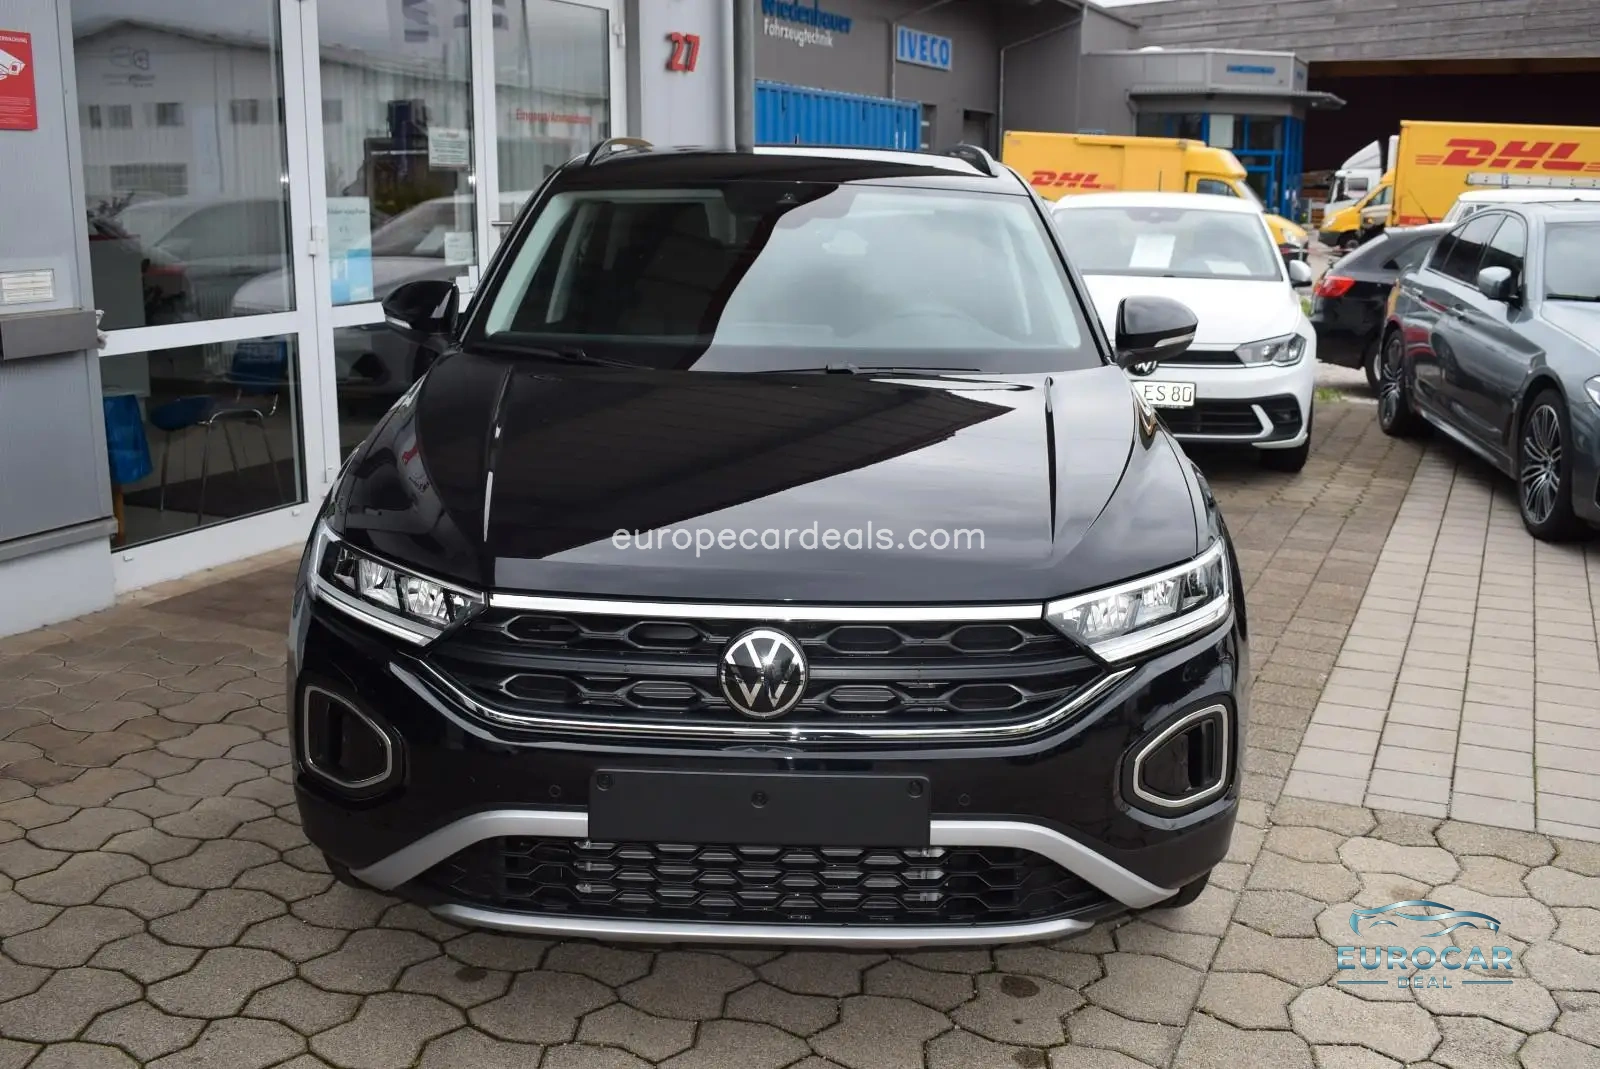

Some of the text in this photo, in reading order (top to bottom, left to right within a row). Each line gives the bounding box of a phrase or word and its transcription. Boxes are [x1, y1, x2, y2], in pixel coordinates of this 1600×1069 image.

[764, 17, 833, 47] Fahrzeugtechnik
[900, 29, 950, 66] IVECO
[667, 32, 700, 72] 27
[1442, 138, 1587, 171] DHL
[1031, 170, 1101, 189] DHL
[1171, 386, 1192, 402] 80
